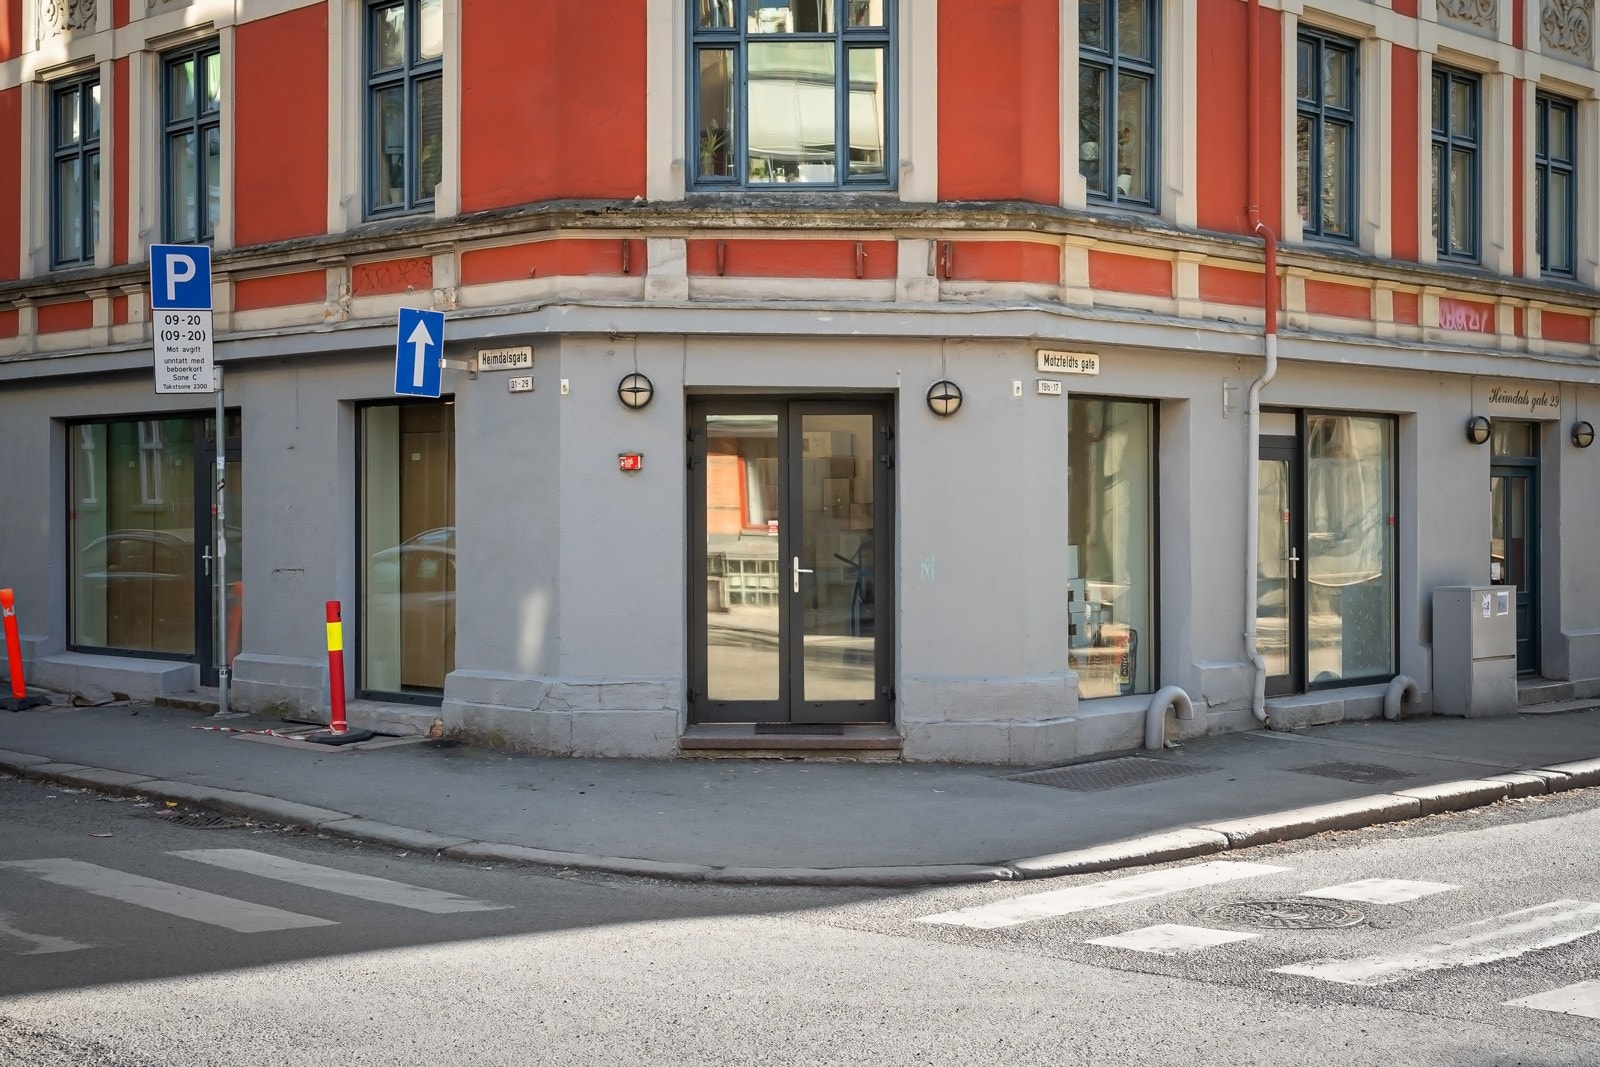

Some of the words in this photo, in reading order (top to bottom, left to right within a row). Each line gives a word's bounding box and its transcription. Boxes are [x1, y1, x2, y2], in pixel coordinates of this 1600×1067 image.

[166, 254, 196, 300] P
[182, 346, 201, 354] avgift
[482, 350, 528, 366] Heimdalsgata
[1043, 353, 1079, 368] Motzfeldts
[1081, 358, 1095, 372] gate
[1489, 387, 1530, 405] Heimdals
[1530, 392, 1548, 413] gate
[1550, 395, 1560, 408] 29
